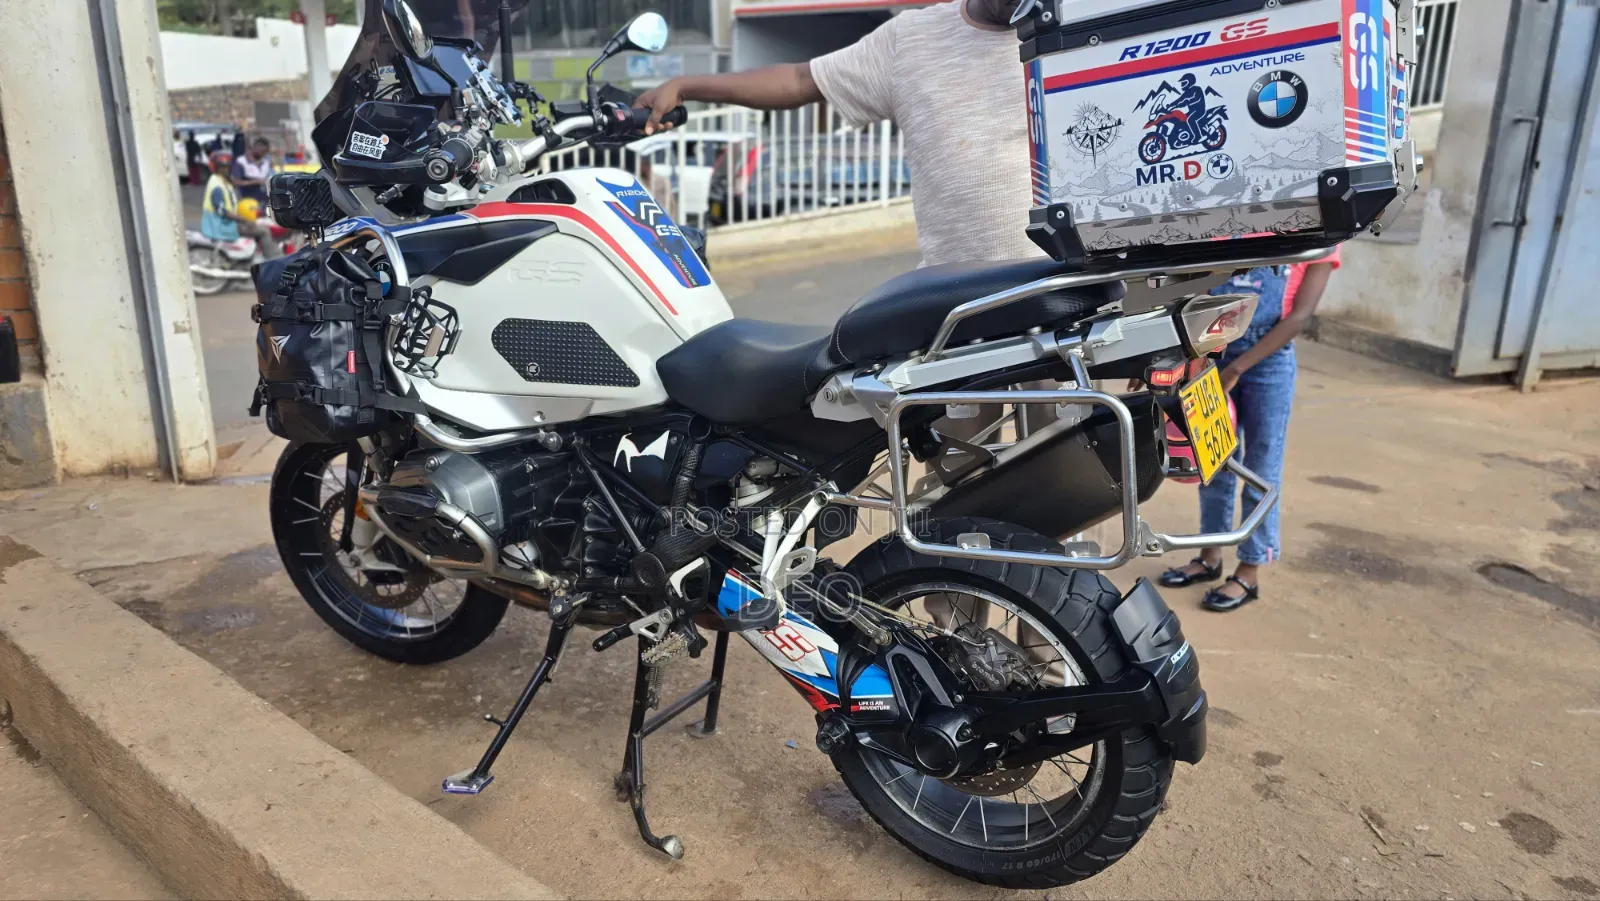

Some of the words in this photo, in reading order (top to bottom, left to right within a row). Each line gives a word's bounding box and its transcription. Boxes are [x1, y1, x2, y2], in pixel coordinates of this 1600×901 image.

[1219, 17, 1269, 43] GS
[1210, 51, 1305, 77] ADVENTURE
[1136, 160, 1202, 187] MR.D
[673, 253, 699, 287] ADVENTURE
[1203, 412, 1233, 467] 567N
[971, 661, 1000, 685] brembo
